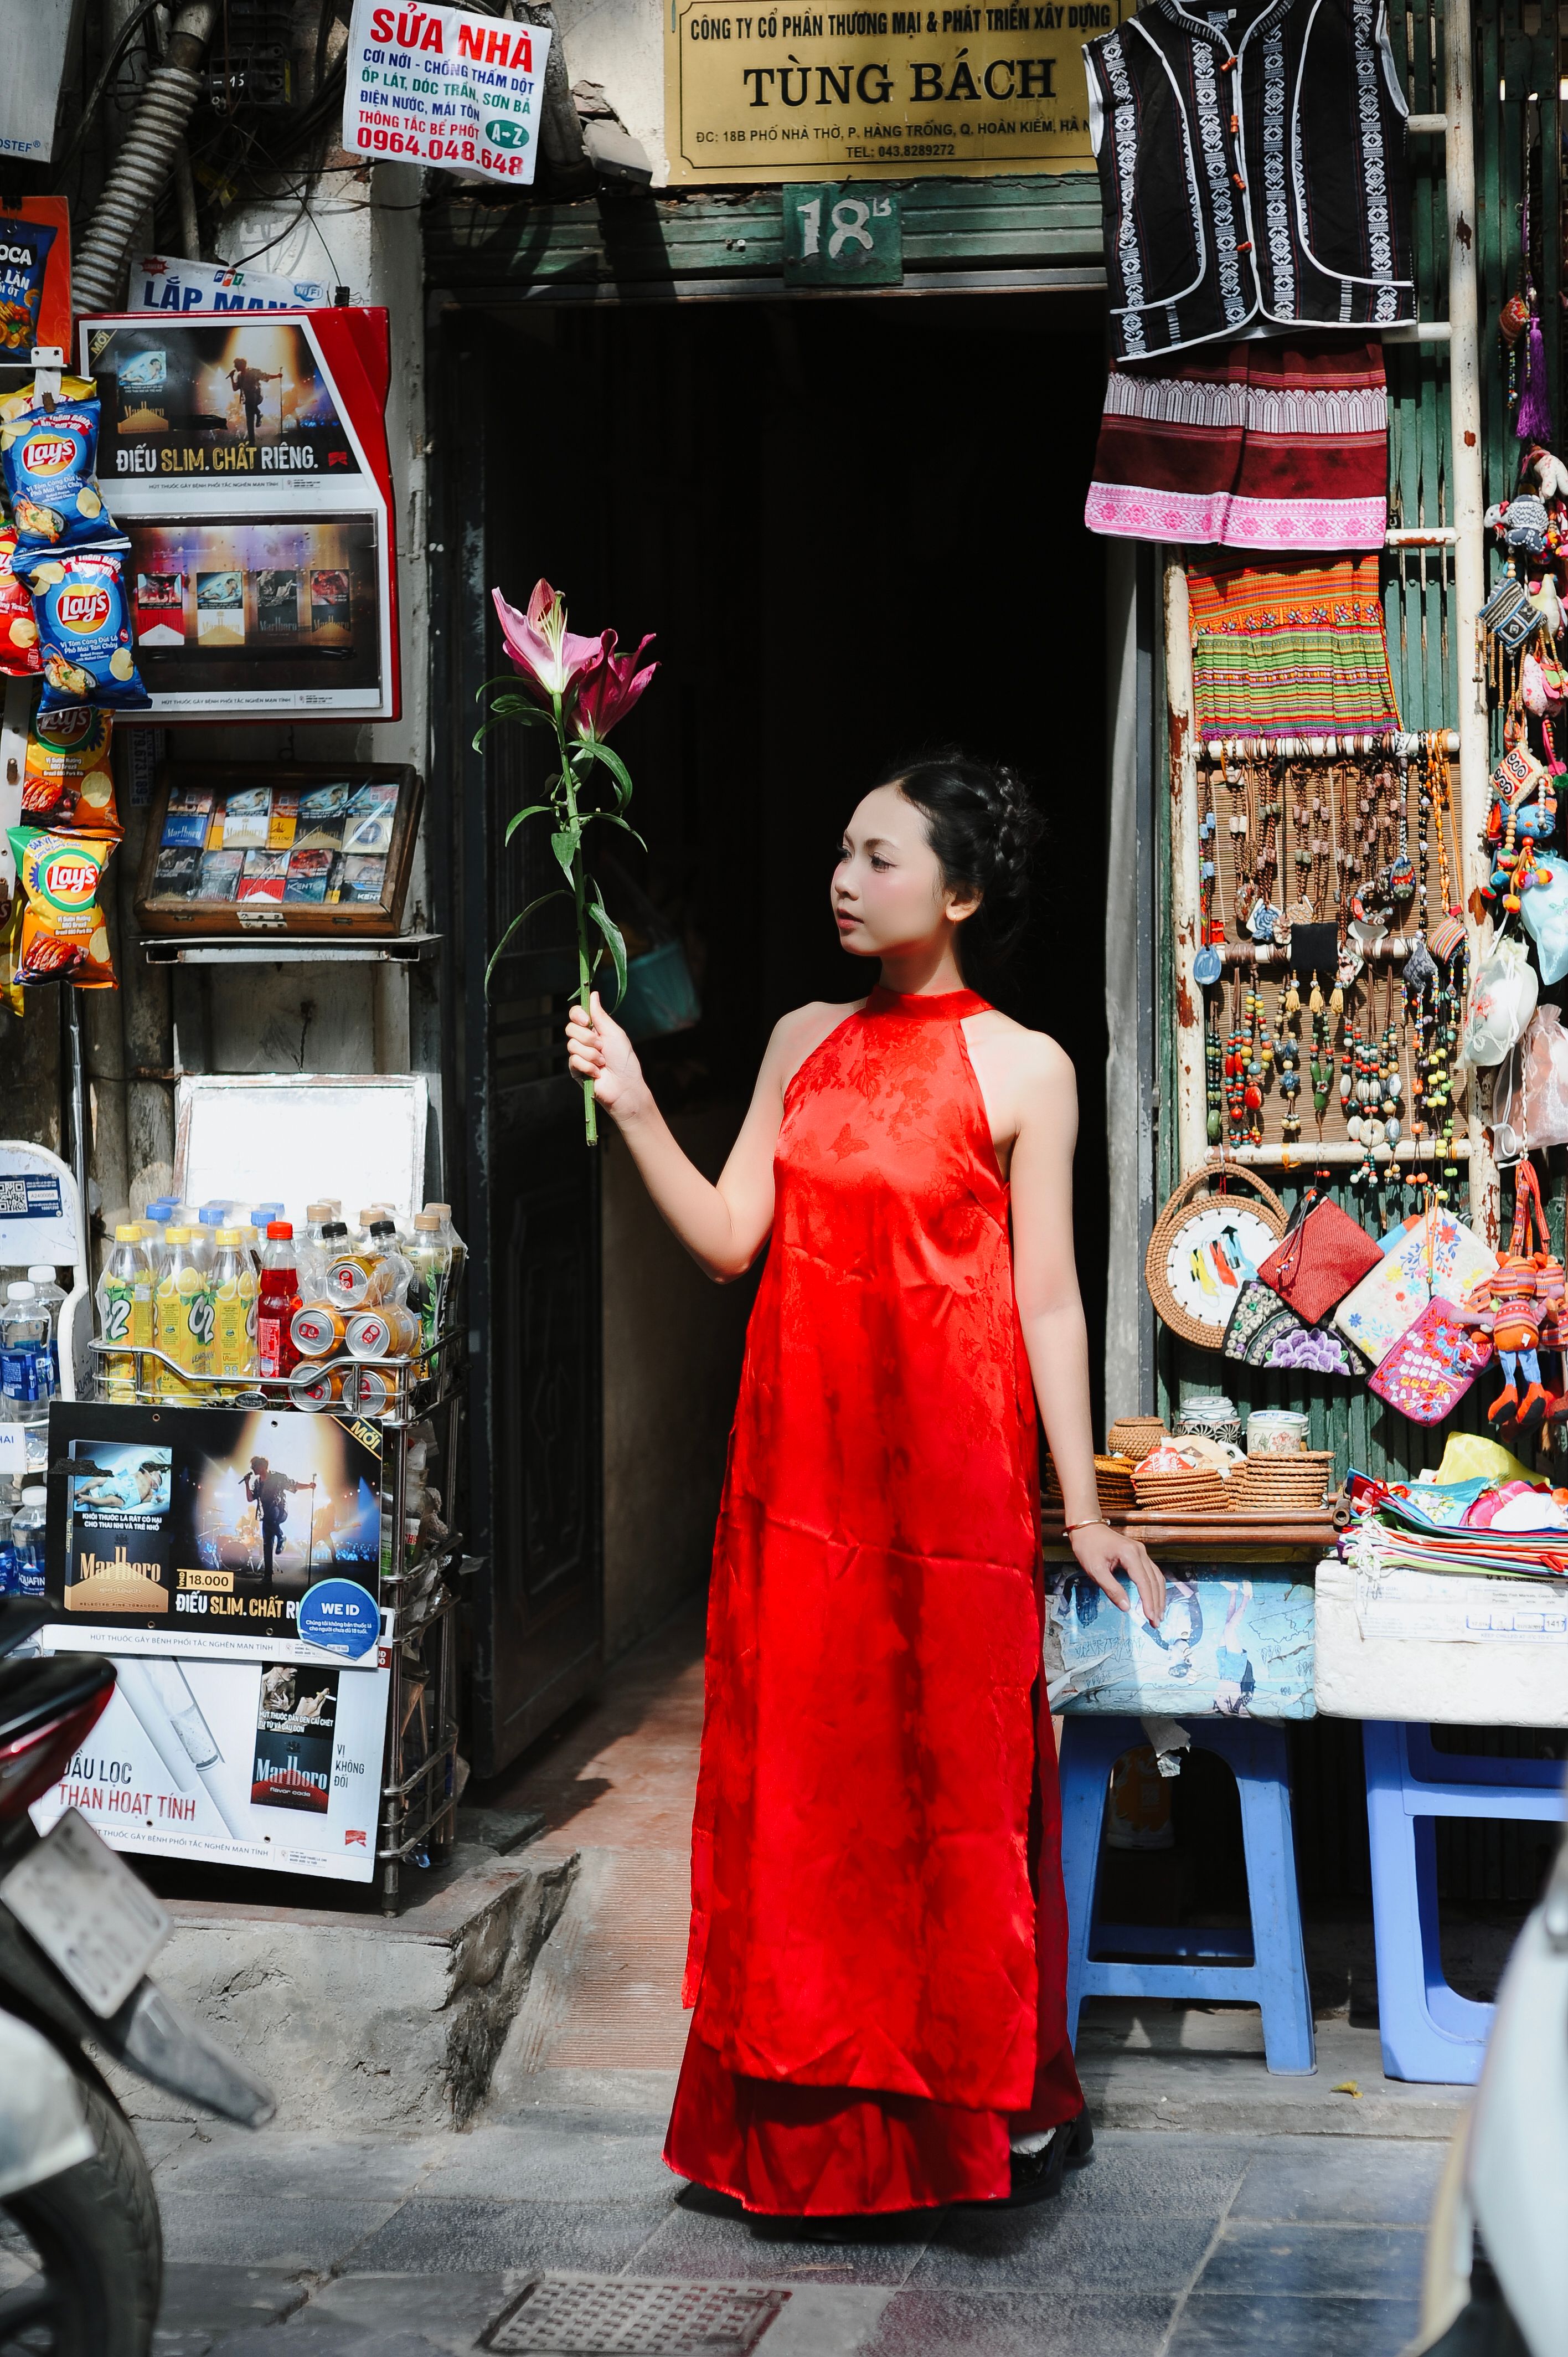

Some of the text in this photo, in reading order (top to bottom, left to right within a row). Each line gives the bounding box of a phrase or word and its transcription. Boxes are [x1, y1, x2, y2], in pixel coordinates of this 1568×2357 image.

[692, 1, 1110, 40] CÔNG TY CỔ PHẦN THƯƠNG MẠI & PHÁT TRIỂN XÂY DỰNG
[370, 2, 533, 73] SỬA NHÀ
[363, 48, 535, 96] CƠI NỚI CHỐNG THẤM DỘT
[743, 48, 1057, 107] TÙNG BÁCH
[362, 65, 379, 83] ỐP
[383, 73, 408, 91] LÁT,
[412, 76, 439, 95] DÓC
[483, 92, 510, 110] SƠN
[514, 97, 531, 114] BẢ
[360, 90, 479, 122] ĐIỆN NƯỚC, MÁI TÔN
[359, 110, 479, 140] THÔNG TẮC BỂ PHỐT
[696, 116, 1079, 143] ĐC: 18B PHỐ NHÀ THỜ, P. HÀNG TRỐNG, Q. HOÀN KIẾM, HÀ
[357, 127, 524, 177] 0964.048.648
[845, 144, 955, 158] TEL: 043.8289272
[143, 276, 203, 311] LẮP
[27, 440, 73, 468] Lay's
[116, 441, 318, 472] ĐIẾU SLIM. CHẤT RIÊNG.
[62, 593, 107, 622] Lay's
[168, 825, 201, 840] Marlboro
[50, 865, 96, 893] Lay's
[287, 881, 313, 894] KENT
[189, 1295, 215, 1345] C2
[350, 1420, 380, 1450] MỚI
[80, 1546, 161, 1582] Marlboro
[189, 1574, 229, 1587] 18.000
[176, 1590, 208, 1614] ĐIẾU
[210, 1596, 247, 1616] SLIM.
[249, 1595, 283, 1618] CHẤT
[321, 1603, 360, 1616] WE ID
[107, 1634, 132, 1643] THUỐC
[337, 1744, 345, 1758] VỊ
[100, 1759, 132, 1787] LỌC
[256, 1755, 328, 1790] Marlboro
[334, 1773, 349, 1788] ĐỔI
[335, 1759, 365, 1774] KHÔNG
[59, 1783, 195, 1821] THAN HOẠT TÍNH
[104, 1829, 128, 1839] THUỐC
